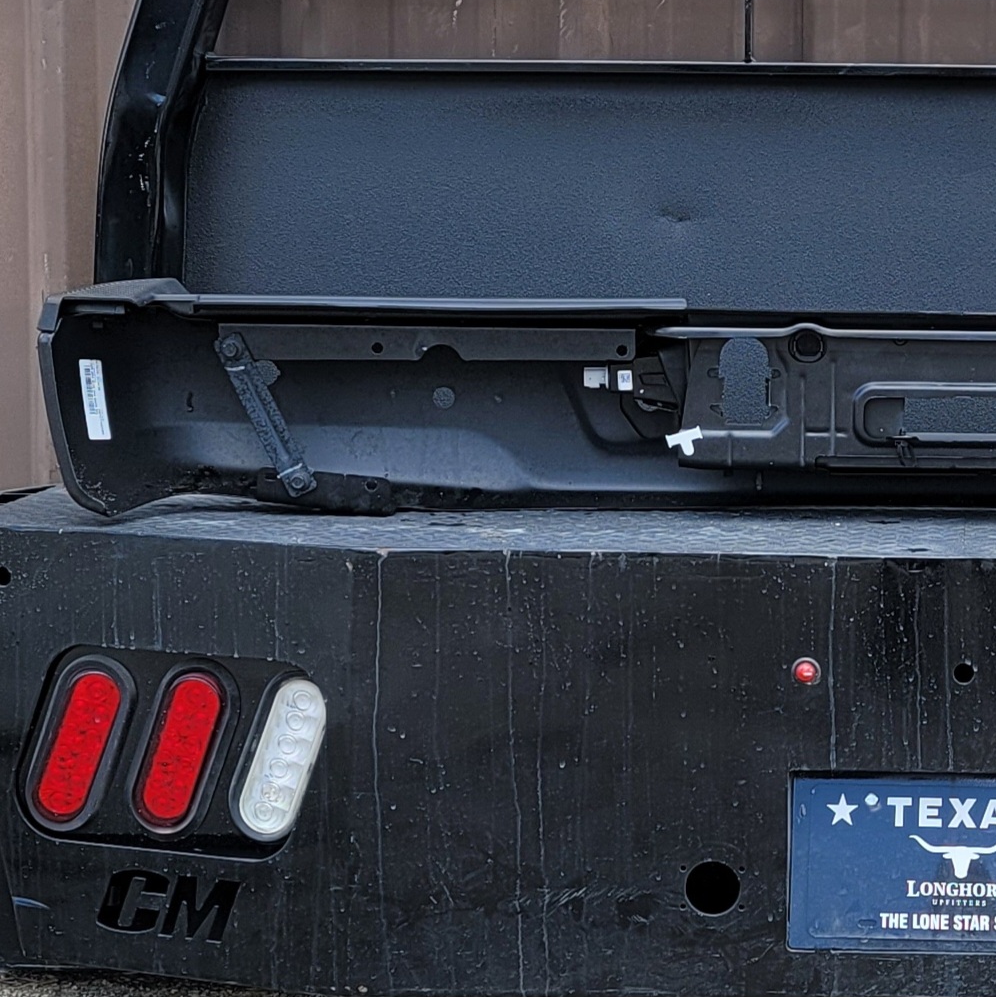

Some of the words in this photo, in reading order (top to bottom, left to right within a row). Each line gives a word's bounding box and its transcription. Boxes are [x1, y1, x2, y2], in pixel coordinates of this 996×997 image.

[96, 868, 243, 945] CM
[931, 898, 988, 907] UPFITTERS
[879, 912, 909, 929] THE
[911, 913, 950, 931] LONE
[952, 914, 991, 932] STAR
